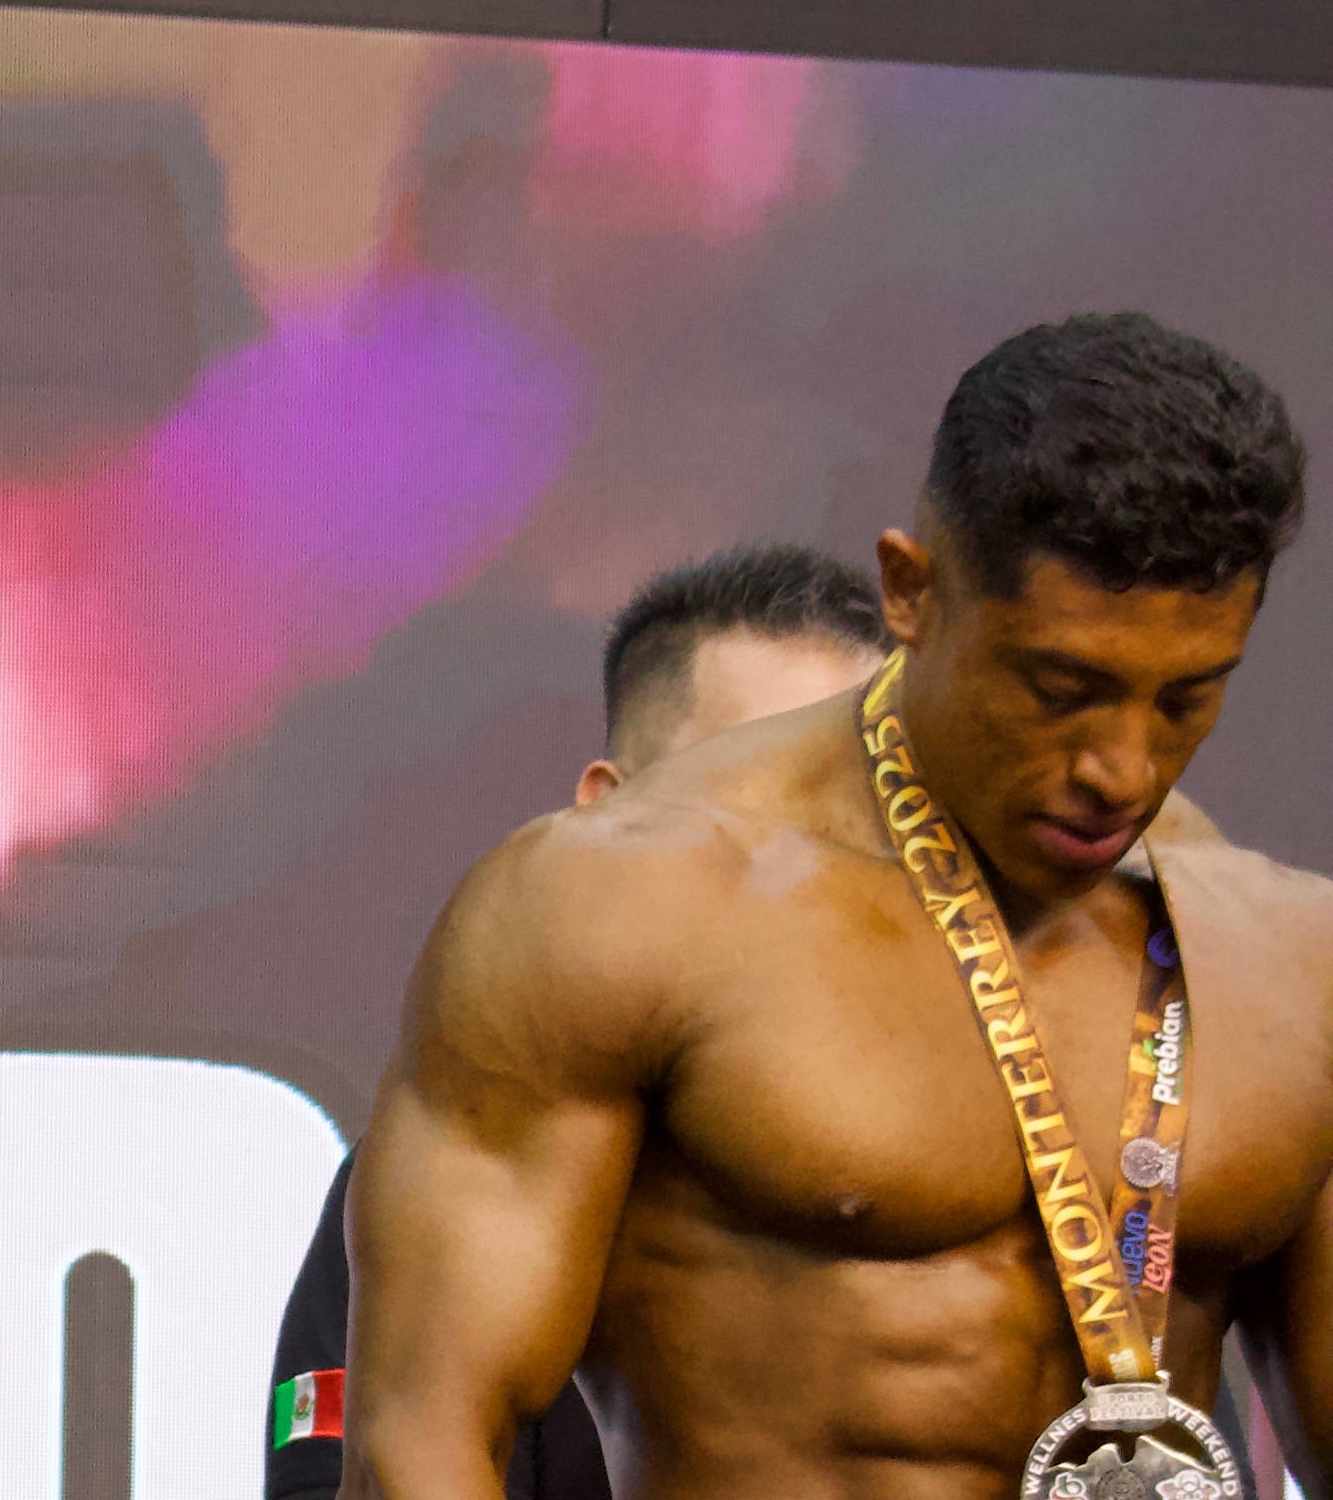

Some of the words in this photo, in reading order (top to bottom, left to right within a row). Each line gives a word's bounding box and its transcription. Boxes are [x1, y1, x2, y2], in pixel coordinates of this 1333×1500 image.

[863, 714, 957, 873] 2025
[922, 886, 1129, 1325] MONTERREY
[1025, 1405, 1087, 1495] WELLNES
[1167, 1402, 1239, 1497] WEEKEND
